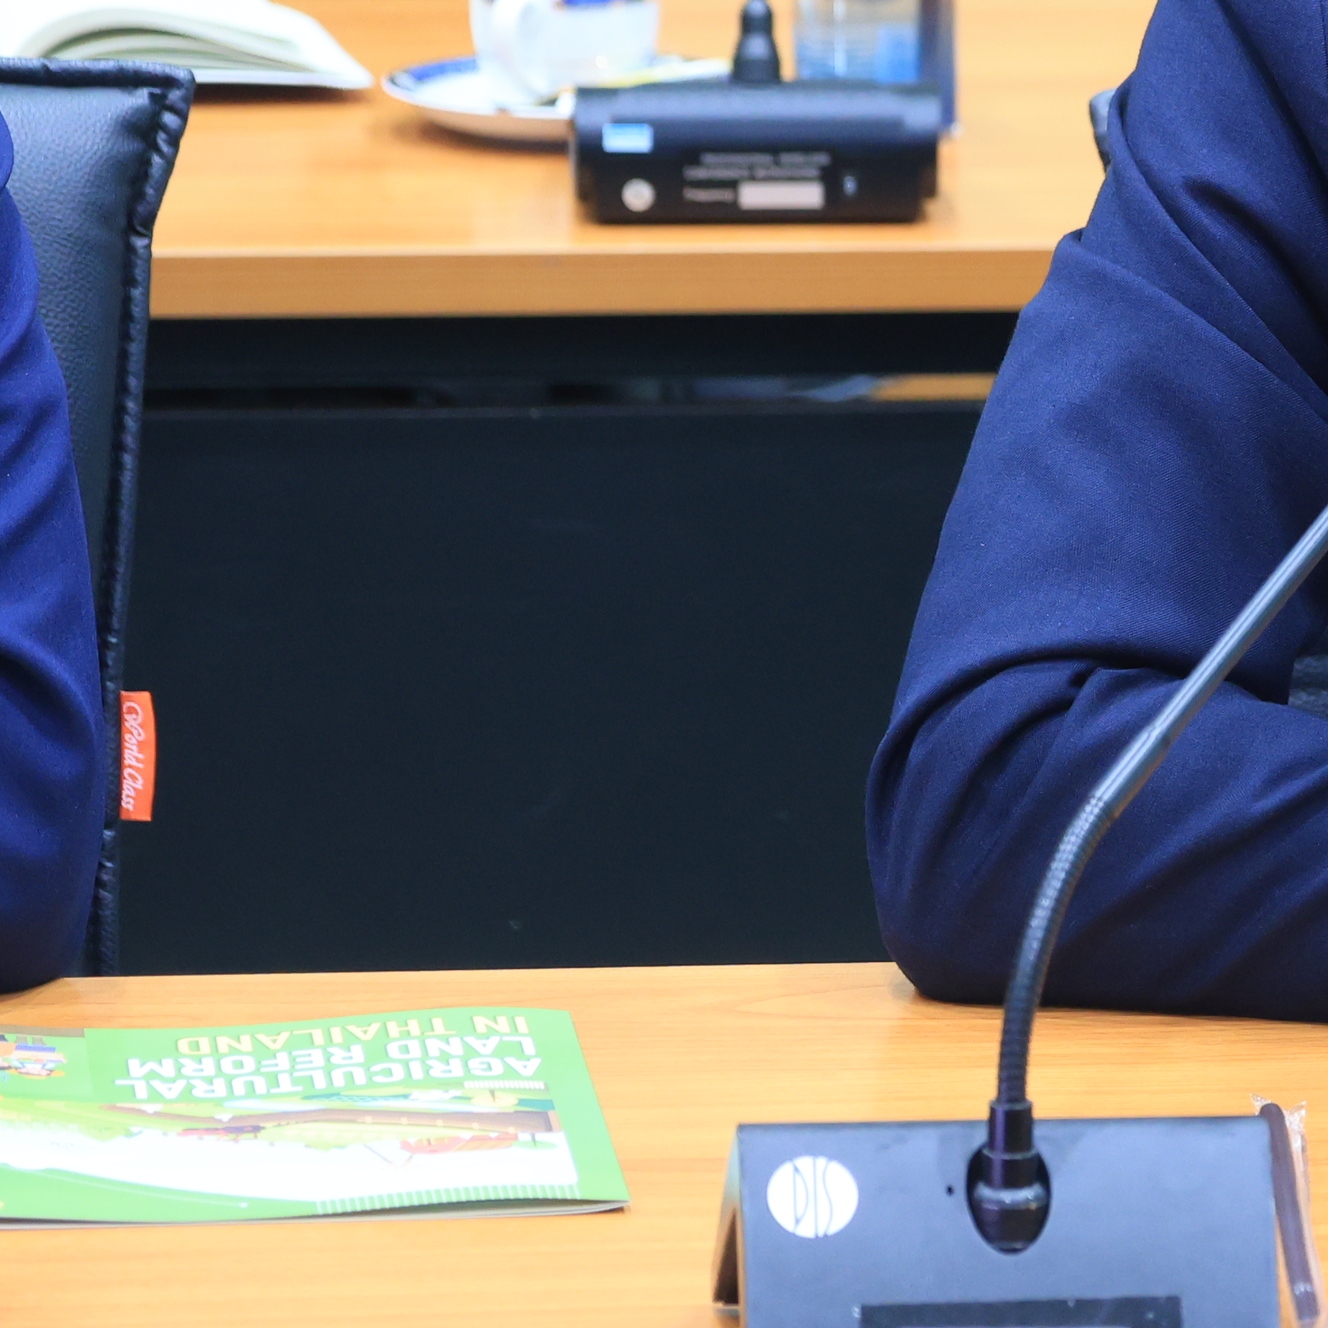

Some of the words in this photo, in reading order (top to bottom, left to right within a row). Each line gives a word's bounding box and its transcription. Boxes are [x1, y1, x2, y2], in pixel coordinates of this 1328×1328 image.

[123, 701, 146, 769] World
[121, 767, 144, 811] Class
[177, 1017, 457, 1056] THAILAND
[471, 1015, 530, 1035] IN
[127, 1045, 361, 1076] REFORM
[387, 1036, 535, 1060] LAND
[114, 1055, 541, 1101] AGRICULTURAL
